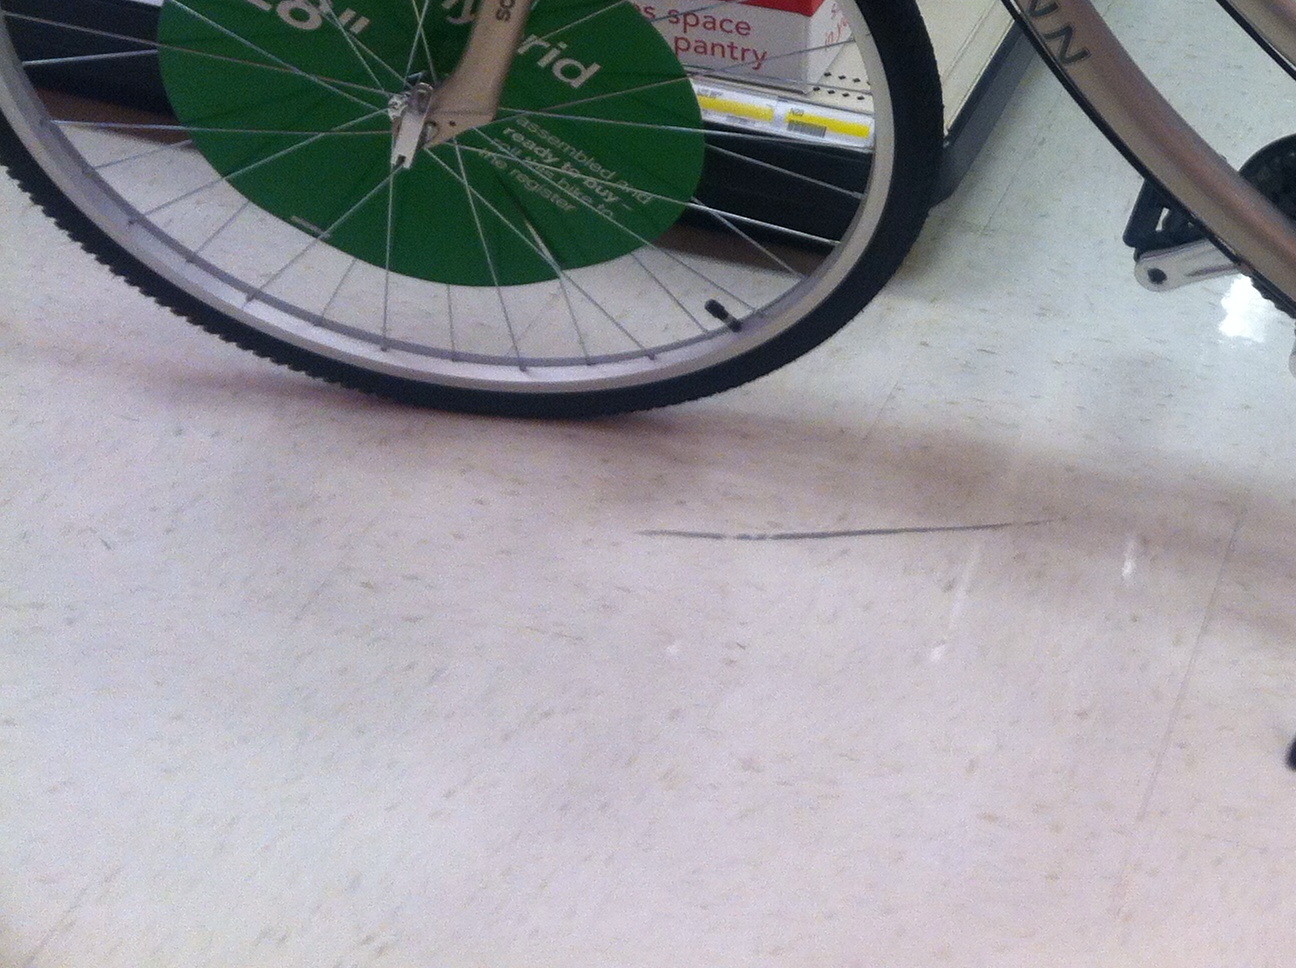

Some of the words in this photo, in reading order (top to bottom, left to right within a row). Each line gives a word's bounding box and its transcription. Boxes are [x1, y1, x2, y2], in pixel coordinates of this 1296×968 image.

[667, 8, 752, 37] space
[673, 35, 768, 70] pantry
[502, 126, 561, 164] ready
[515, 116, 617, 181] assembled
[509, 168, 578, 212] register
